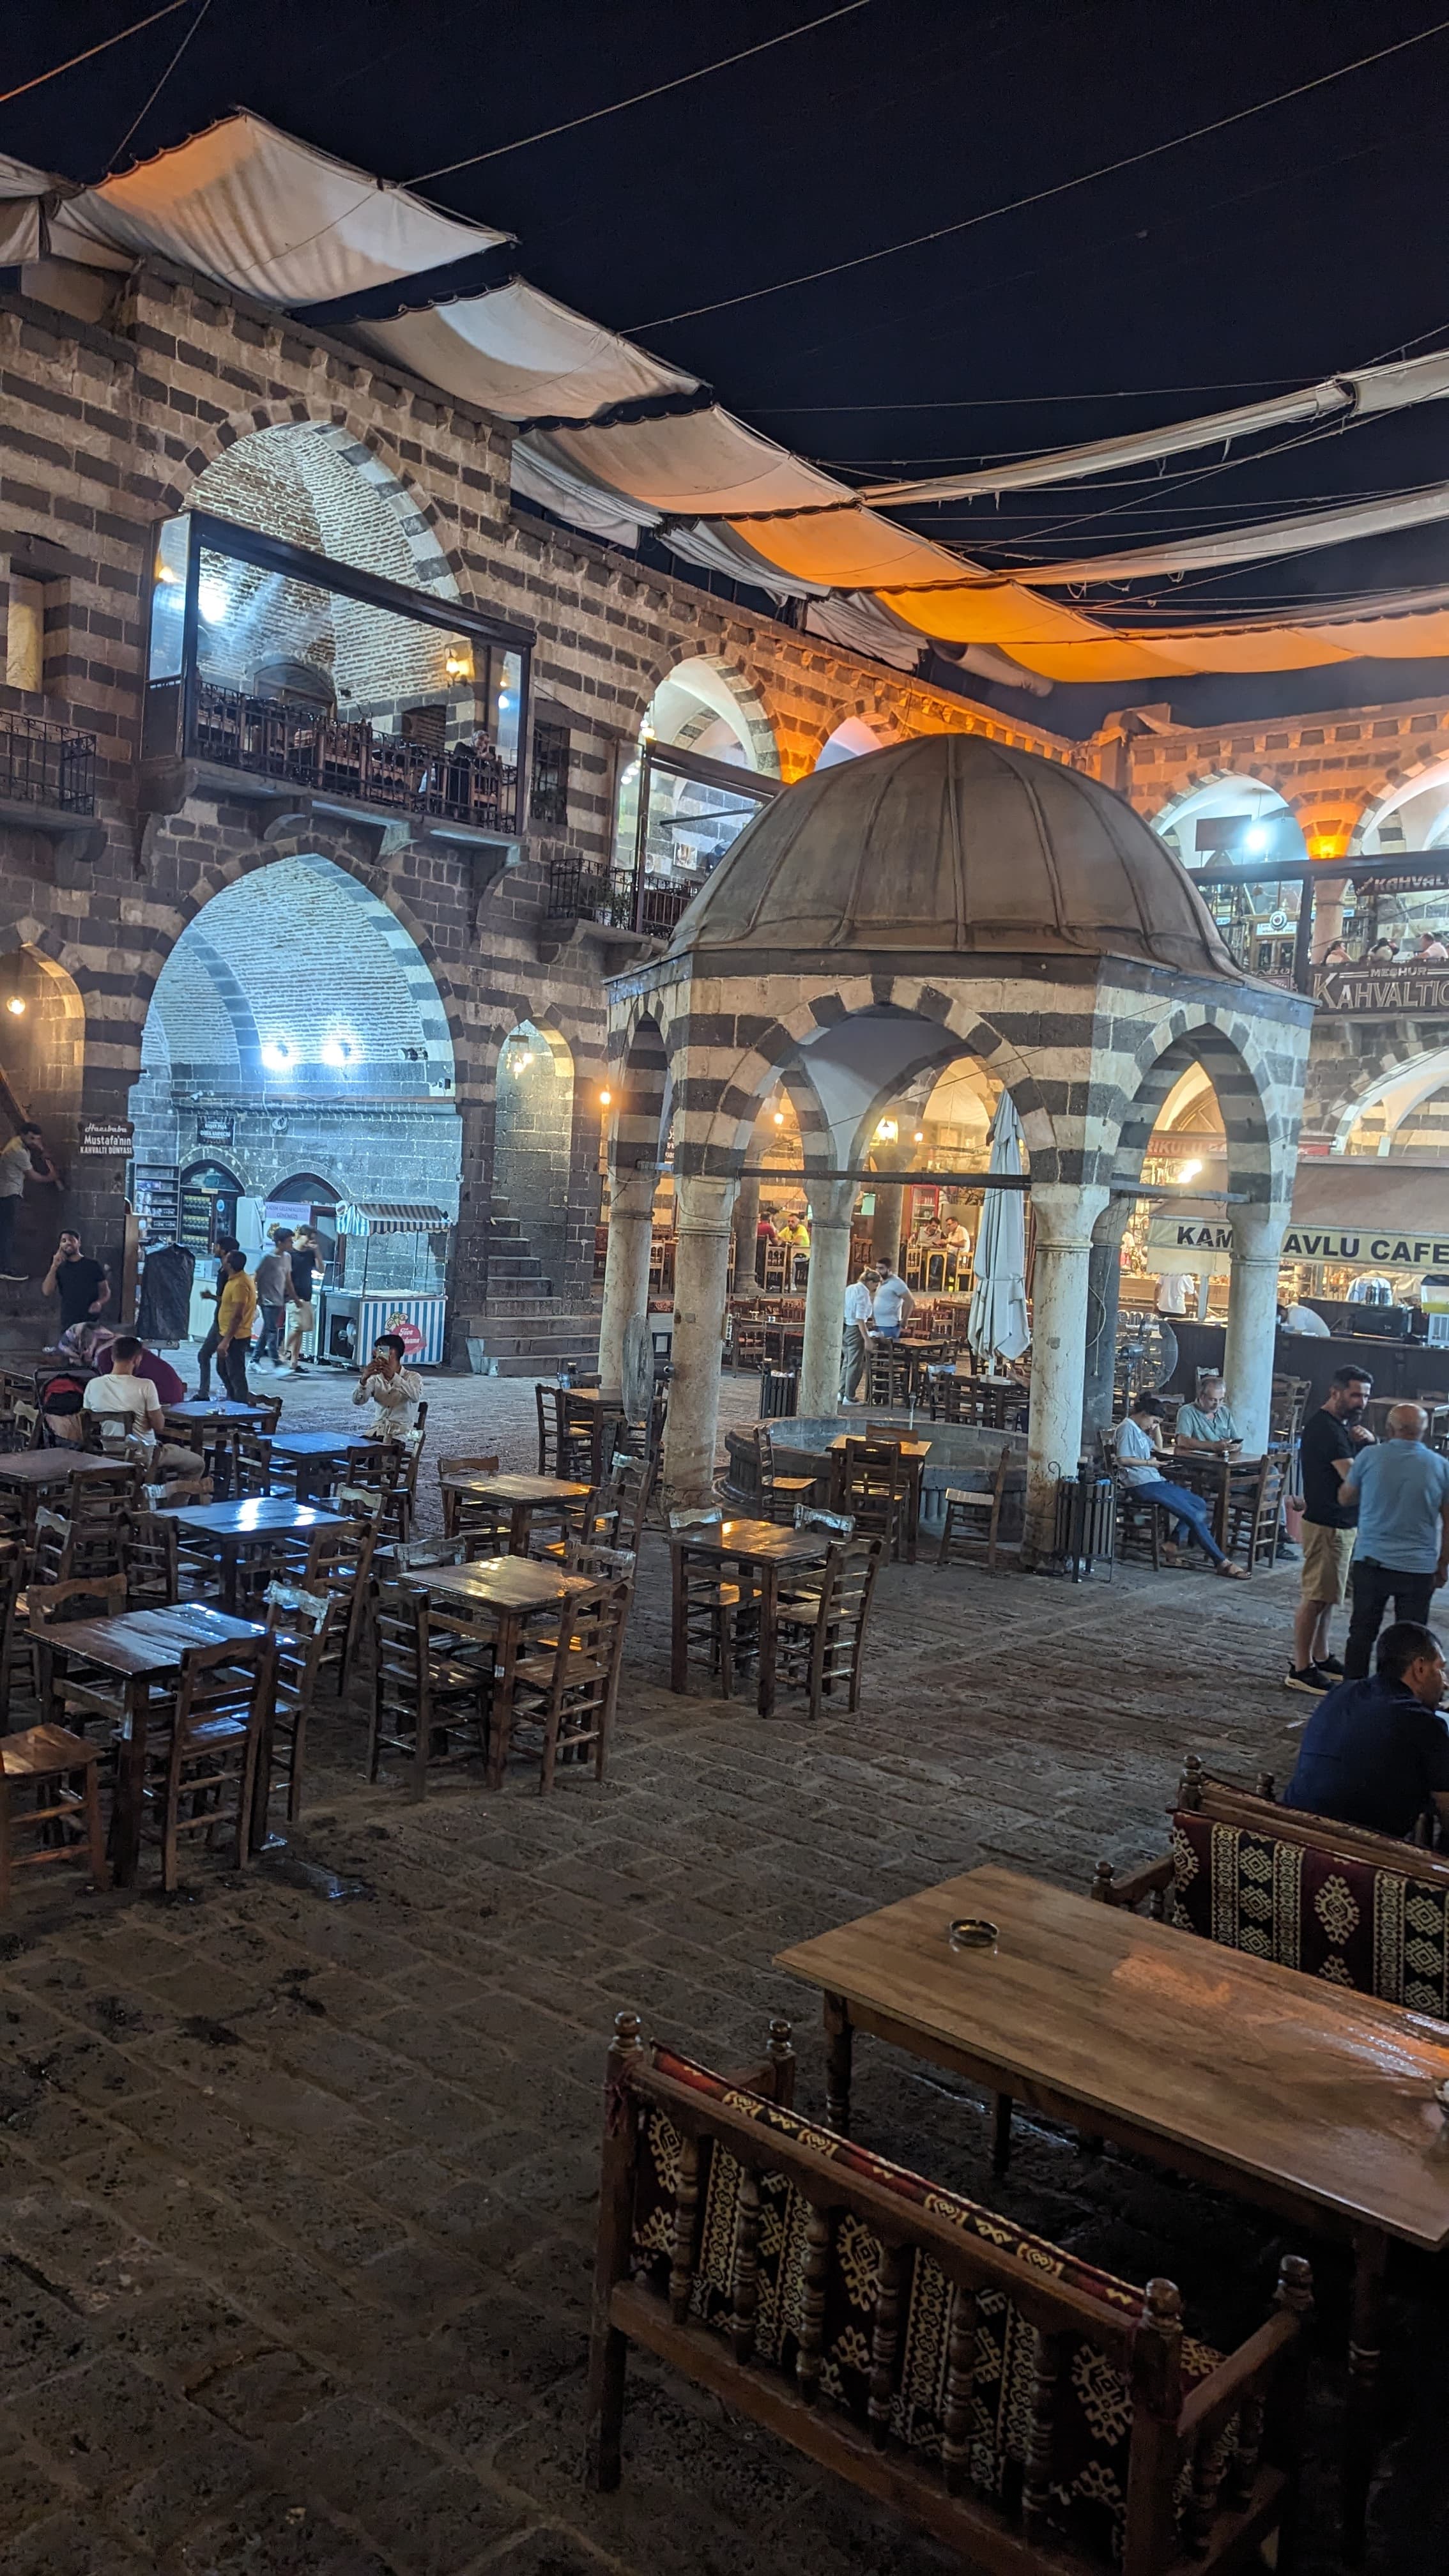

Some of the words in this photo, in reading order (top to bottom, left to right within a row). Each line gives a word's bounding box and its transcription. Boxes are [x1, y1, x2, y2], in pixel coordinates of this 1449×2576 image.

[1374, 874, 1449, 891] KAHVAL
[84, 1135, 131, 1146] Mustafa'nın
[80, 1146, 107, 1154] KAHVALTI
[108, 1146, 132, 1154] DÜNYASI
[1176, 1226, 1234, 1249] KAM
[1283, 1233, 1360, 1258] AVLU
[1370, 1239, 1449, 1264] CAFE
